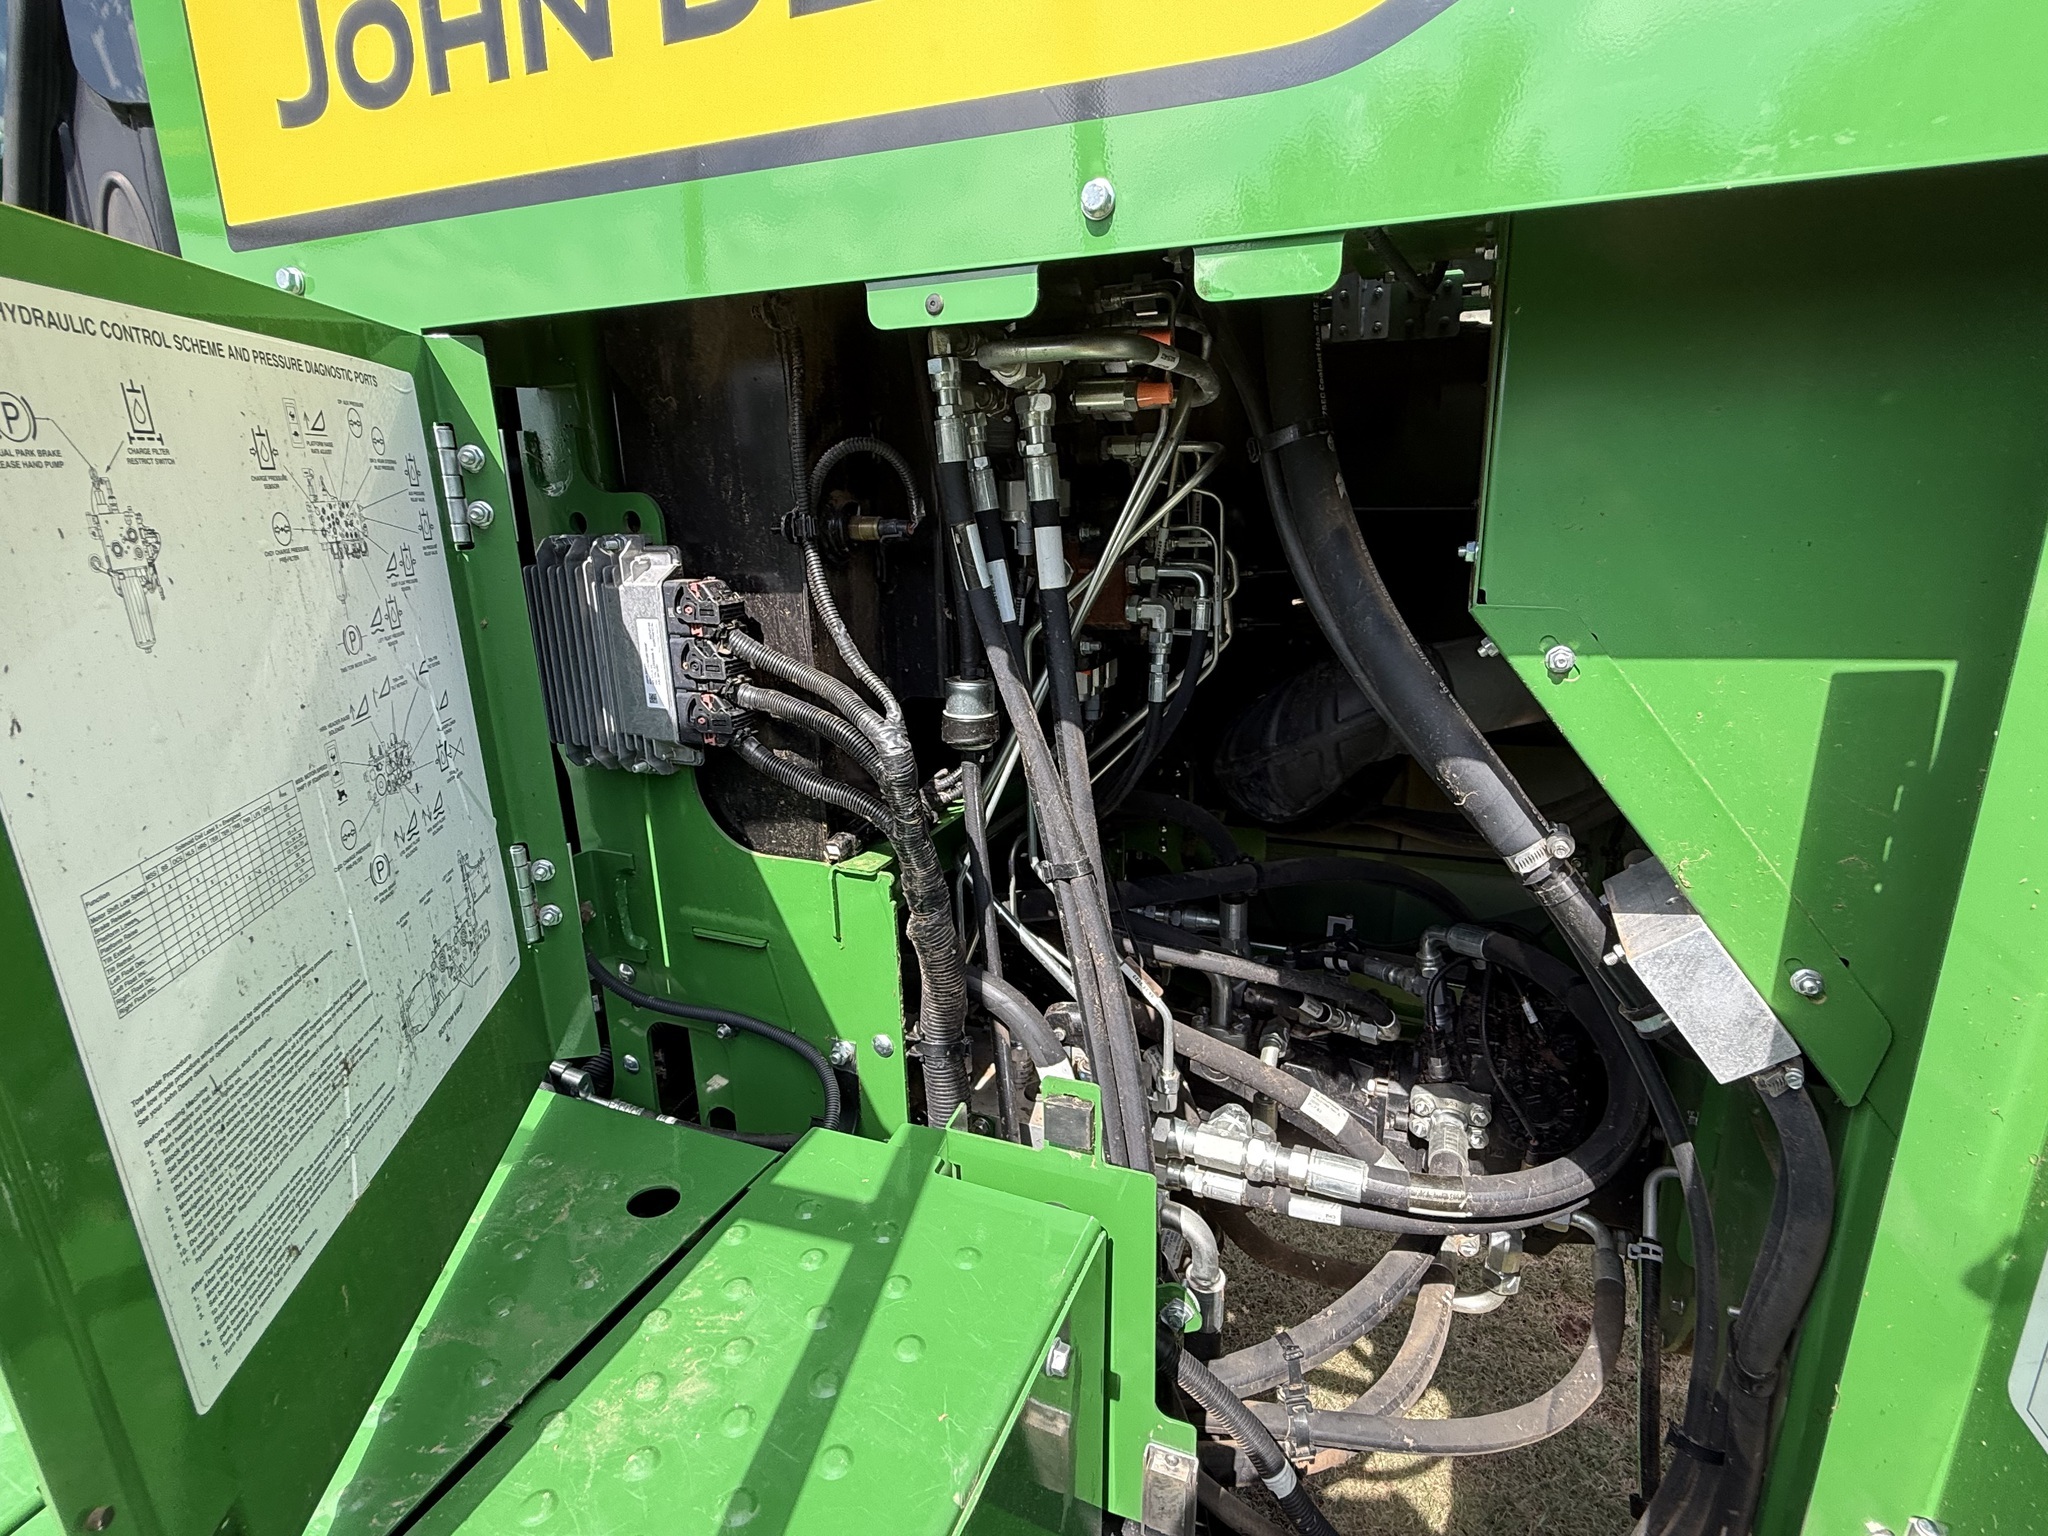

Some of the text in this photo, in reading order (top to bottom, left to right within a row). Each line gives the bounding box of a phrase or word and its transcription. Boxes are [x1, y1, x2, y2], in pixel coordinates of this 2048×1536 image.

[100, 320, 172, 349] CONTROL
[173, 334, 225, 358] SCHEME
[228, 345, 250, 362] AND
[252, 349, 304, 372] PRESSURE
[304, 360, 353, 382] DIAGNOSTIC
[354, 371, 378, 387] PORTS
[15, 448, 62, 457] PARK BRAKE
[22, 460, 44, 469] HAND
[44, 459, 64, 469] PUMP
[127, 446, 151, 455] CHARGE
[84, 892, 111, 909] Function
[130, 1054, 192, 1107] Tow Mode Procedure
[134, 1105, 147, 1118] Use
[146, 1095, 158, 1107] tow
[158, 1081, 174, 1097] mode
[174, 1058, 201, 1085] procedure
[200, 1045, 214, 1060] when
[214, 1032, 228, 1049] power
[229, 1023, 239, 1034] may
[137, 1115, 149, 1128] See
[149, 1102, 163, 1119] your
[164, 1090, 178, 1105] John
[177, 1076, 193, 1092] Deere
[193, 1061, 209, 1078] dealer
[143, 1086, 208, 1148] Before Towing Machine
[158, 1132, 172, 1147] Park
[172, 1111, 194, 1134] machine
[161, 1142, 175, 1155] Turn
[174, 1123, 193, 1143] hazard
[193, 1112, 203, 1126] and
[164, 1148, 181, 1165] Block
[191, 1228, 244, 1294] After Towing Machine
